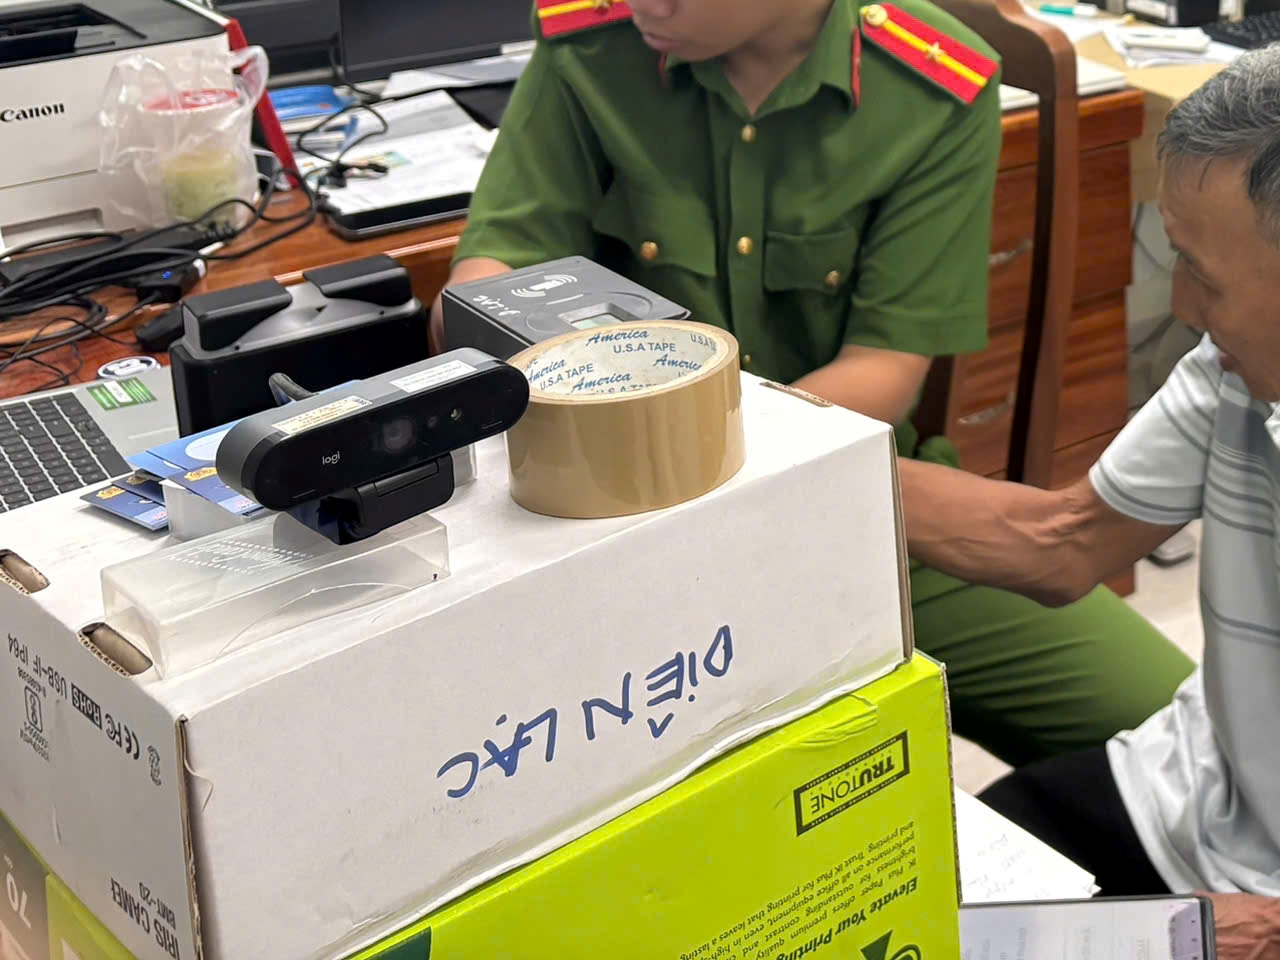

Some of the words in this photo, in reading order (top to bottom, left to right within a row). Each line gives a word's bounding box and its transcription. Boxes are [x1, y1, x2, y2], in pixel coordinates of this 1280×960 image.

[0, 103, 64, 122] Canon
[585, 329, 649, 347] America
[613, 343, 645, 354] U.S.A
[648, 342, 676, 352] TAPE
[566, 363, 594, 378] TAPE
[653, 354, 702, 371] Americ
[570, 372, 632, 393] America
[322, 451, 341, 465] logi
[33, 655, 67, 701] USB-IF
[436, 708, 557, 799] LẠC
[811, 756, 895, 814] TRUTONE
[900, 821, 914, 834] and
[867, 831, 914, 865] performance
[844, 852, 865, 866] Trust
[876, 846, 915, 873] brightness
[816, 870, 833, 882] Plus
[842, 872, 850, 883] all
[854, 864, 864, 874] on
[888, 865, 903, 878] Plus
[803, 881, 814, 891] for
[817, 879, 839, 896] office
[860, 873, 871, 884] for
[861, 878, 883, 896] Paper
[6, 872, 32, 930] 70
[767, 886, 800, 911] printing
[806, 883, 854, 916] outstanding
[870, 876, 917, 913] Elevate
[767, 894, 814, 926] equipment,
[832, 895, 855, 913] offers
[747, 910, 765, 924] that
[791, 910, 827, 939] premium
[835, 909, 866, 935] Your
[719, 921, 745, 940] leaves
[744, 924, 764, 940] even
[765, 916, 799, 941] contrast
[154, 919, 180, 960] IRIS
[733, 937, 741, 947] in
[743, 941, 759, 956] and
[756, 937, 785, 960] quality
[680, 943, 710, 960] lasting
